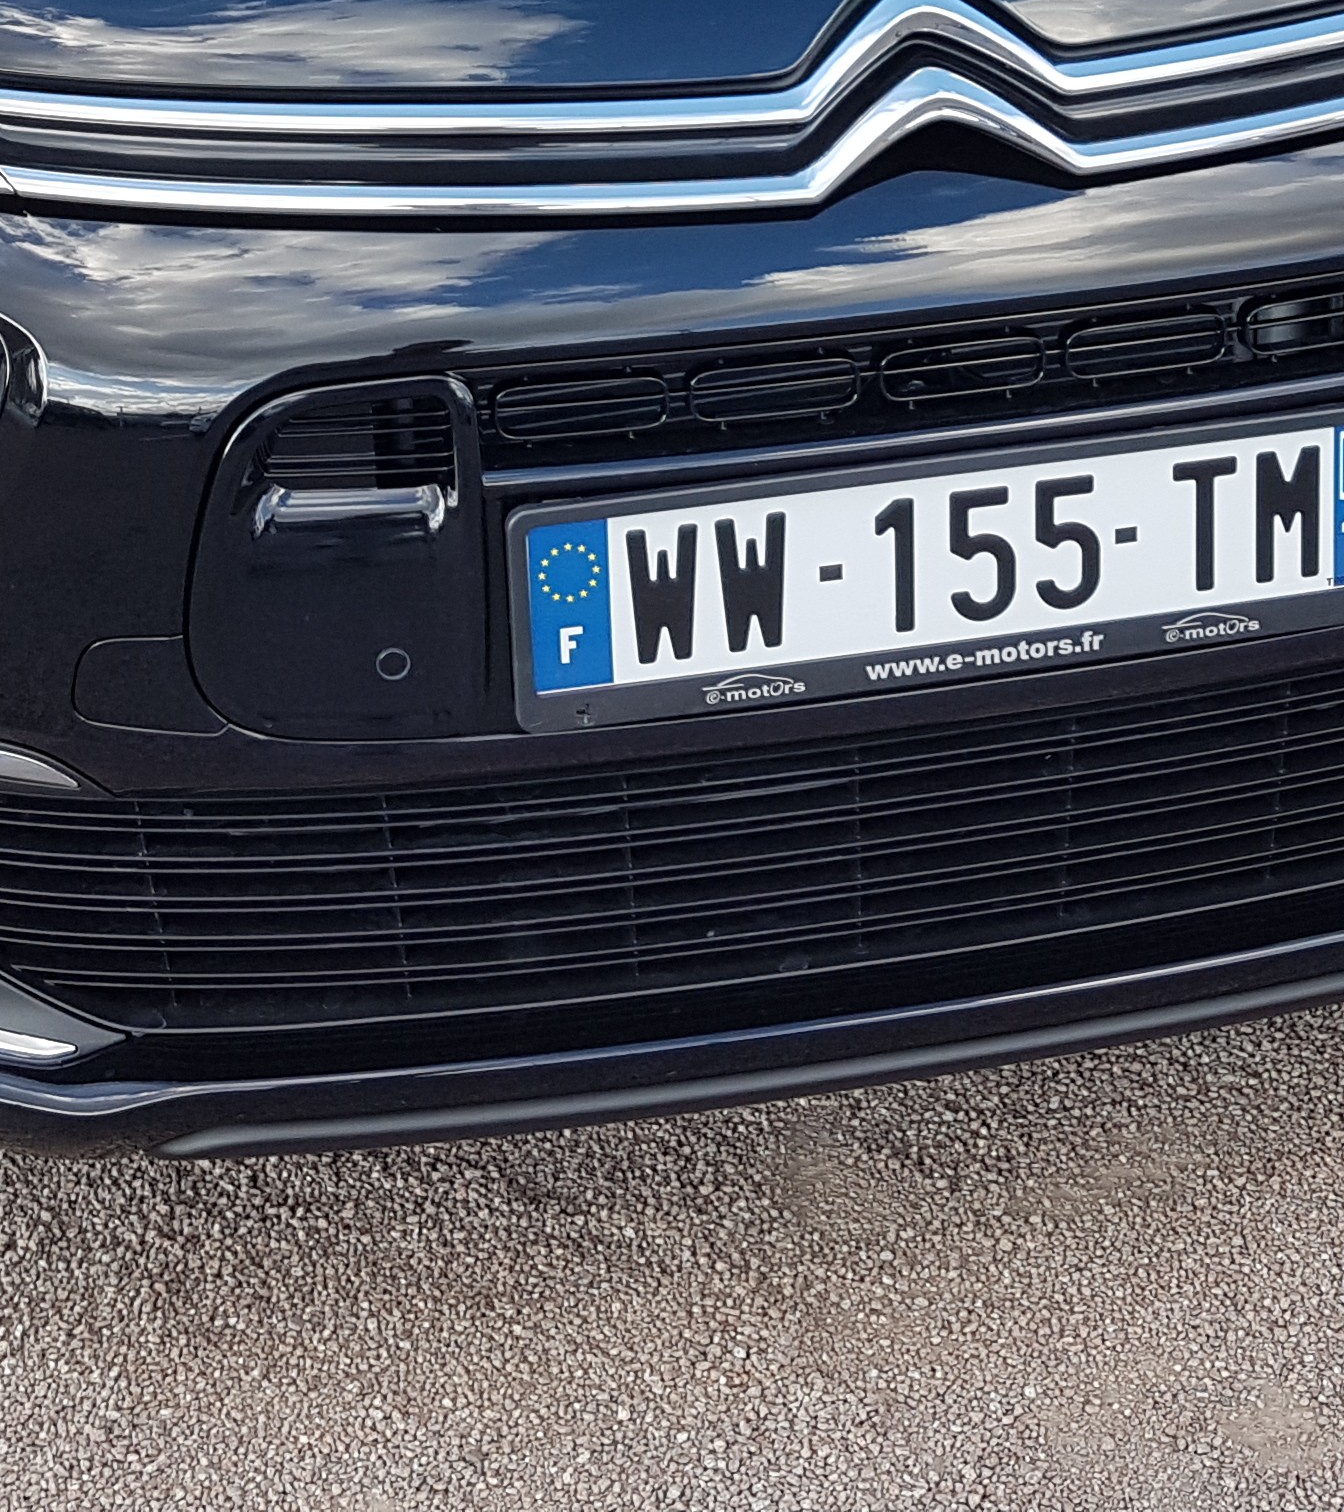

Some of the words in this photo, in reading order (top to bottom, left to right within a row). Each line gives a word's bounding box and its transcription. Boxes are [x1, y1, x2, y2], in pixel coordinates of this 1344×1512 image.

[560, 626, 584, 664] F
[1166, 618, 1260, 643] e-motors
[866, 630, 1104, 681] www.e-motors.fr
[706, 680, 806, 705] e-motors
